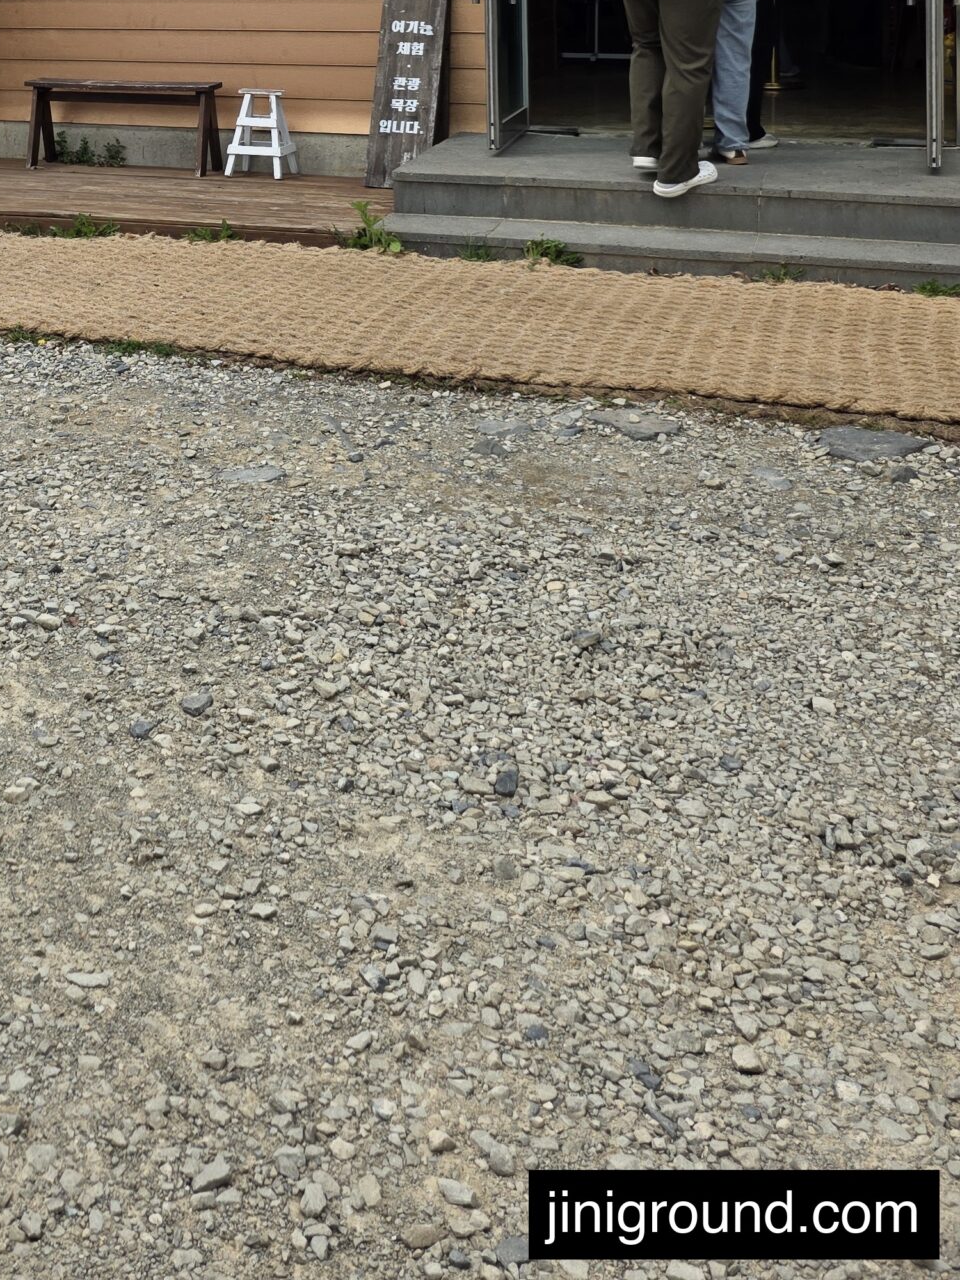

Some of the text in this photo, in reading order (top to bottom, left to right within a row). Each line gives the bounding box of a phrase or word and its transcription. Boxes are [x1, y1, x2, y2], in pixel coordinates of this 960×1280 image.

[391, 20, 434, 36] 여기는
[395, 41, 425, 56] 체험
[392, 76, 421, 91] 관광
[390, 98, 420, 112] 목장
[379, 119, 424, 134] 입니다.
